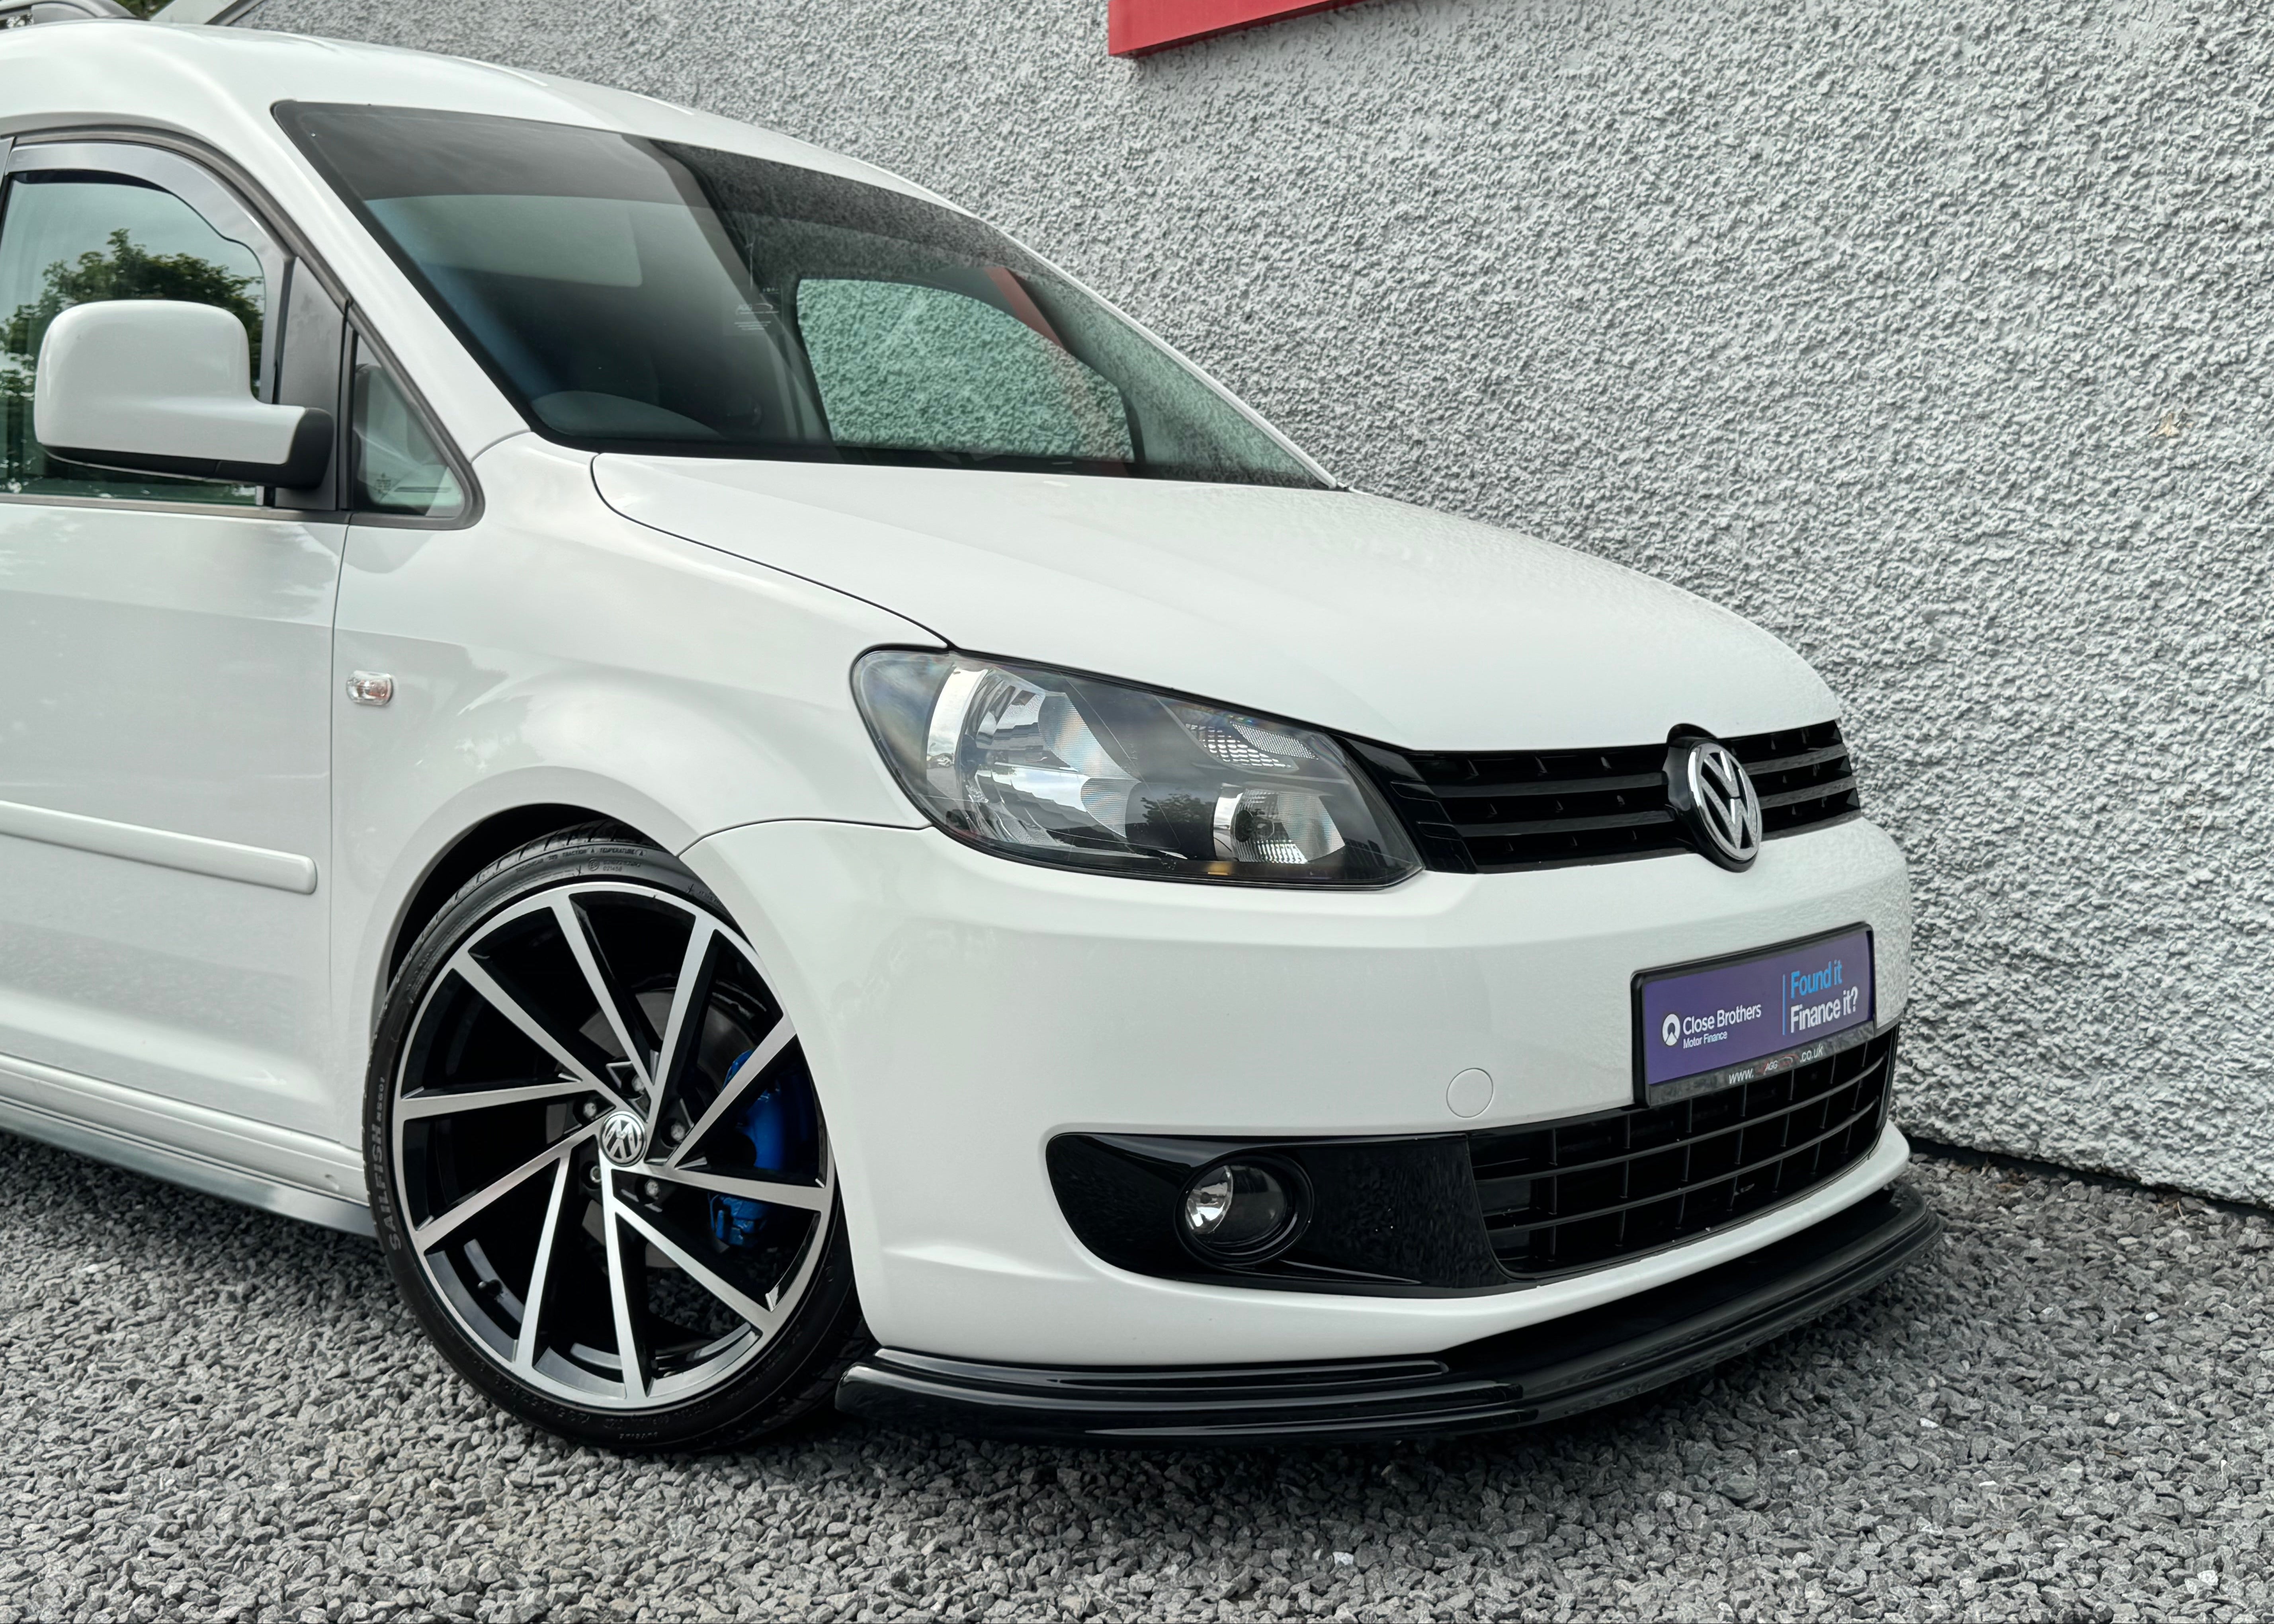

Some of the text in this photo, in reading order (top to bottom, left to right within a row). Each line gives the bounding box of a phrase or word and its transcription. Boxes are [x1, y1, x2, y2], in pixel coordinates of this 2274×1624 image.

[1791, 959, 1842, 999] Found it
[1682, 1004, 1762, 1035] Close Brothers
[1791, 986, 1858, 1033] Finance it?
[1683, 1031, 1727, 1049] Motor Finance
[371, 1123, 402, 1250] SAILFISH
